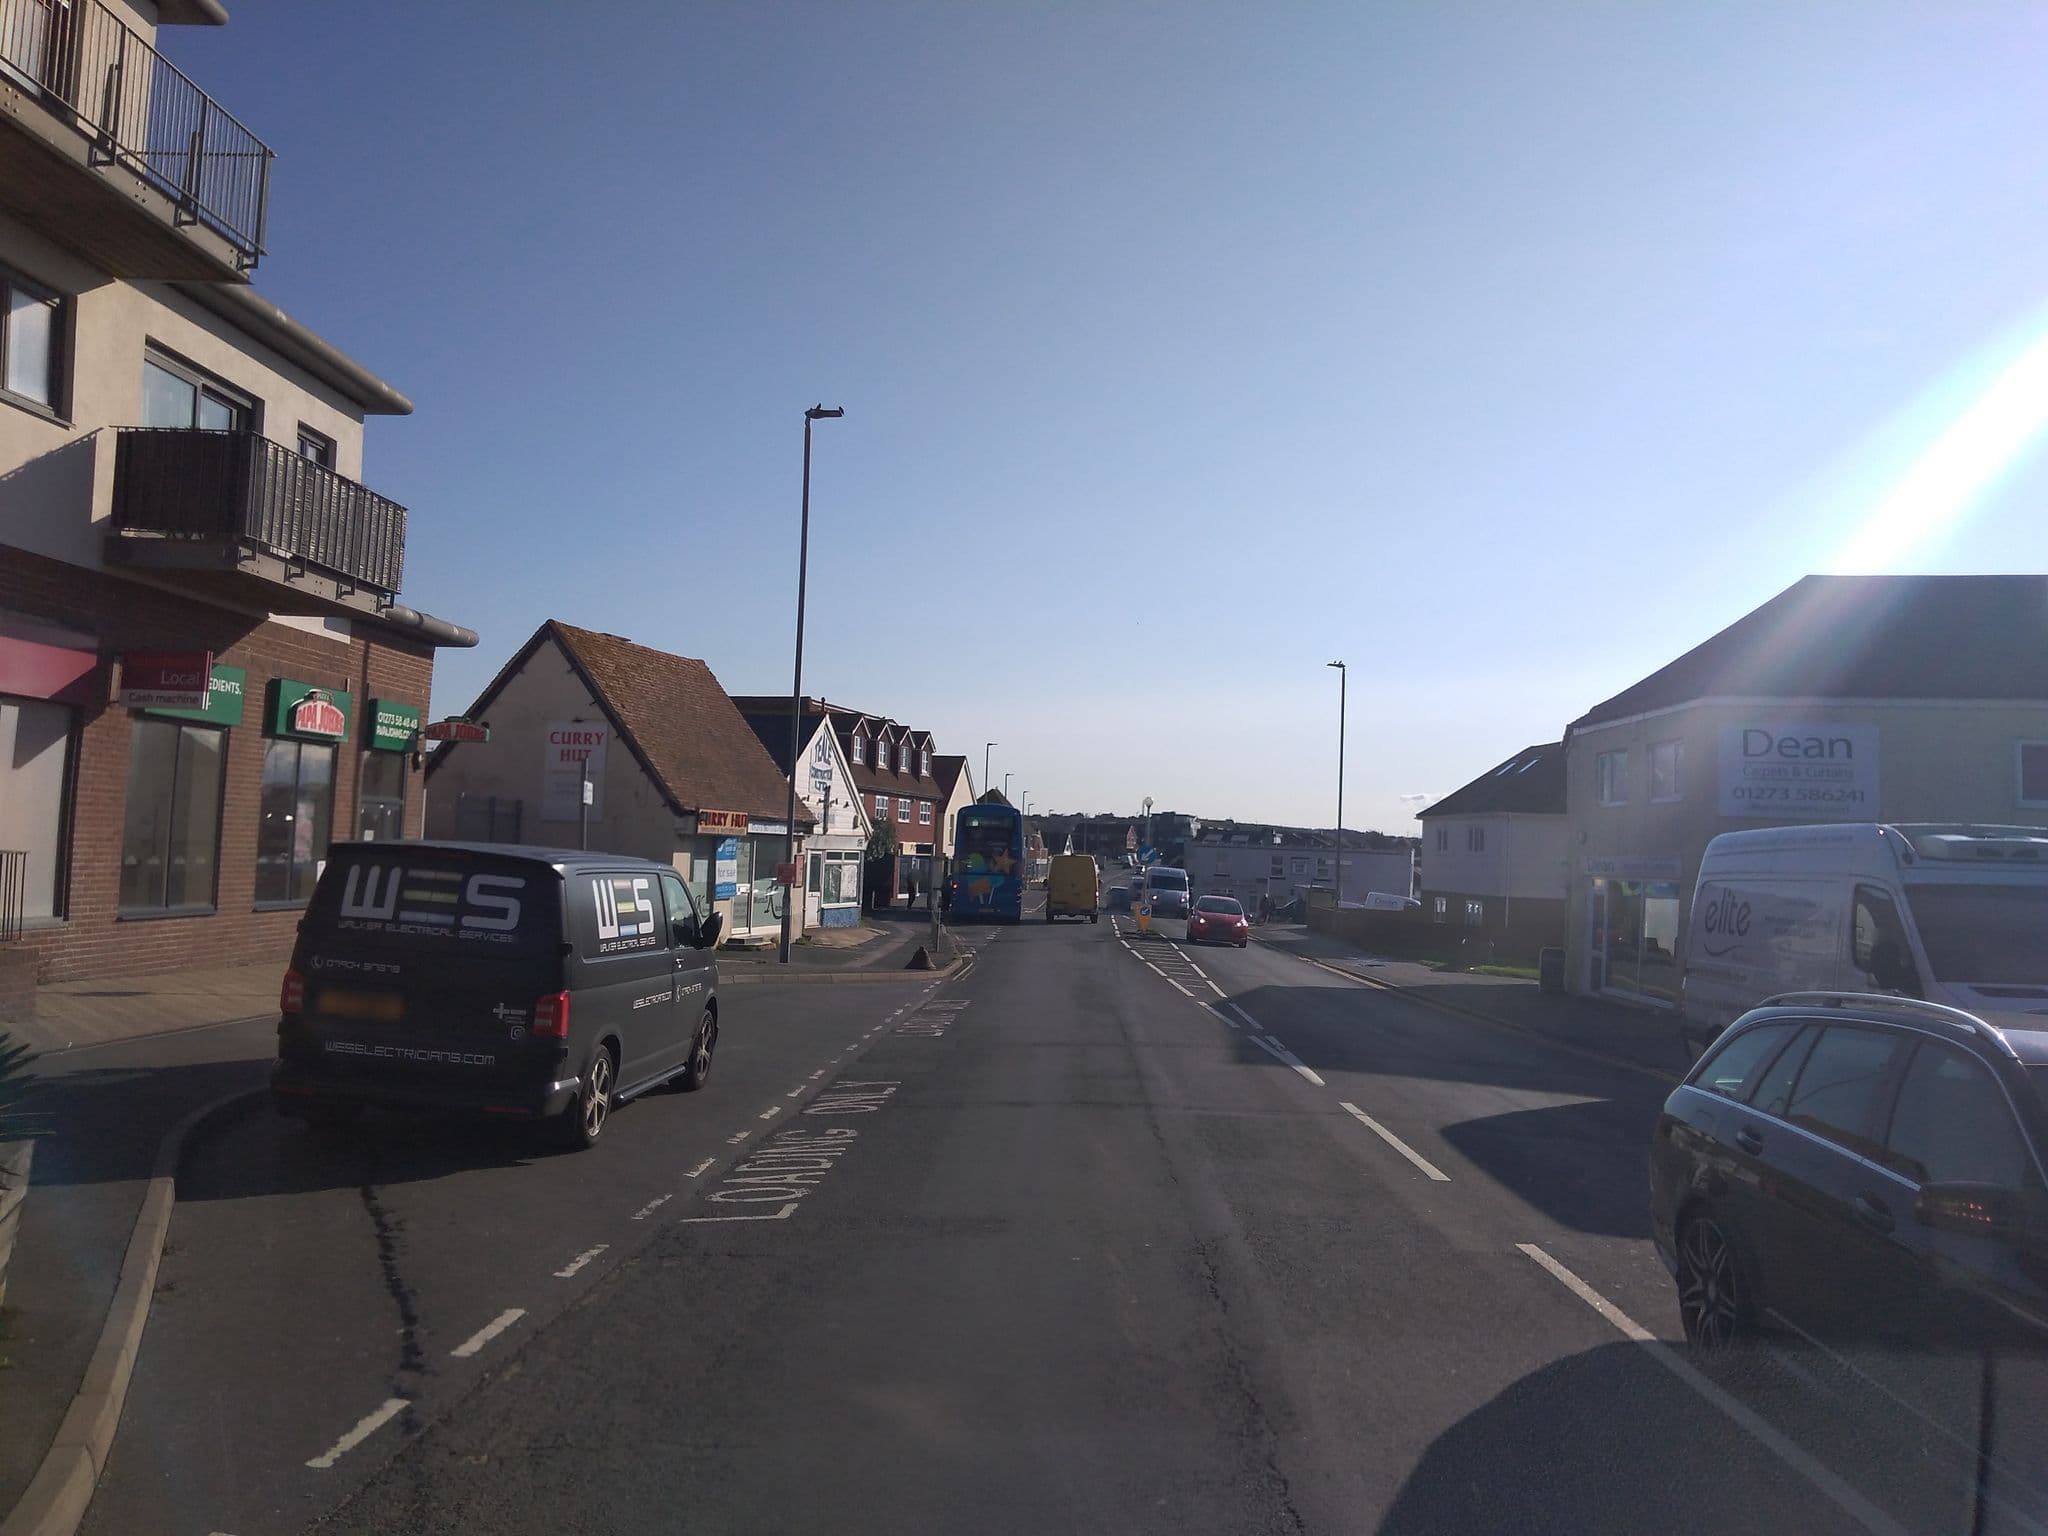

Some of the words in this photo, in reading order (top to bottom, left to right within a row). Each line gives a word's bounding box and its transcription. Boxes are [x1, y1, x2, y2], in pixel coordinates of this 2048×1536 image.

[160, 669, 201, 686] Local
[128, 691, 154, 703] Cash
[155, 693, 200, 705] machine
[549, 731, 605, 746] CURRY
[1742, 728, 1854, 761] Dean
[1733, 786, 1790, 801] 01273
[700, 811, 728, 827] CURRY
[340, 864, 526, 931] WES
[592, 878, 655, 940] WES
[1705, 886, 1752, 938] elite
